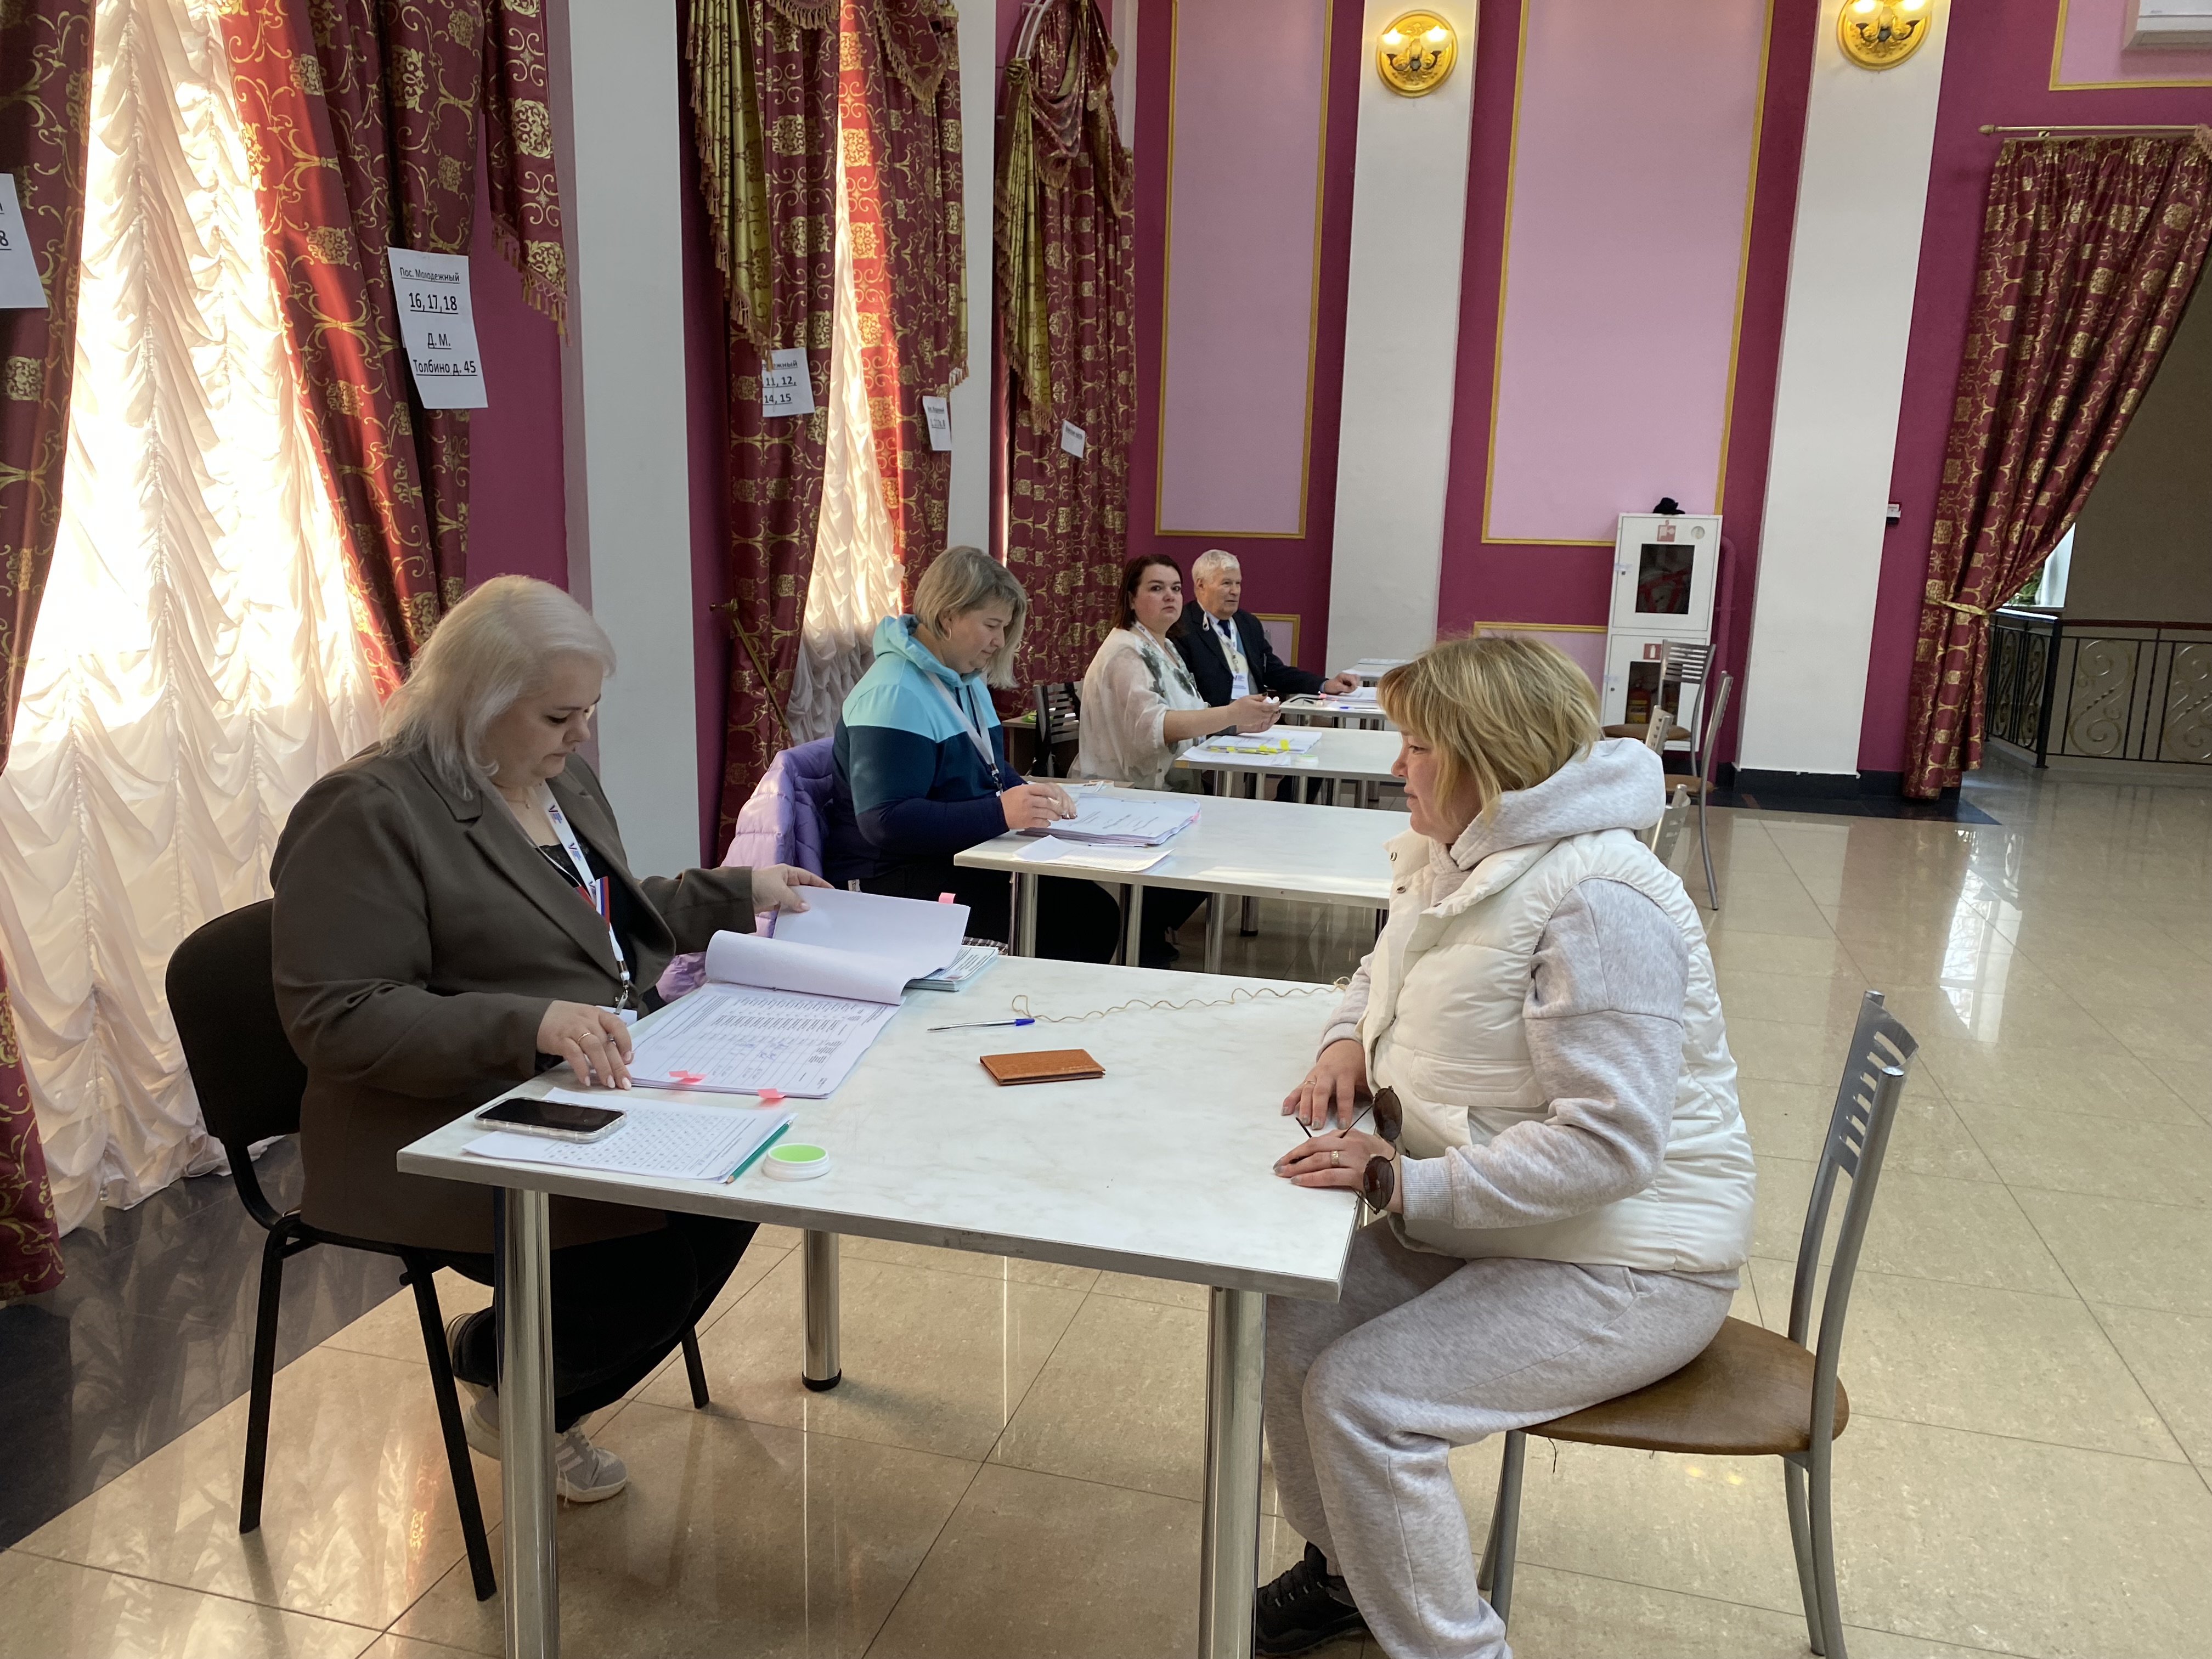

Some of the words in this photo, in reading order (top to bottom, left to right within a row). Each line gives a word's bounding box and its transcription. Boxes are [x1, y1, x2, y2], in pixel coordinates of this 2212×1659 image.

[400, 267, 414, 277] Пос.
[428, 333, 437, 348] Д.
[439, 334, 450, 346] М.
[413, 359, 450, 373] Толбино
[453, 364, 461, 376] д.
[464, 361, 476, 373] 45
[780, 393, 792, 402] 15
